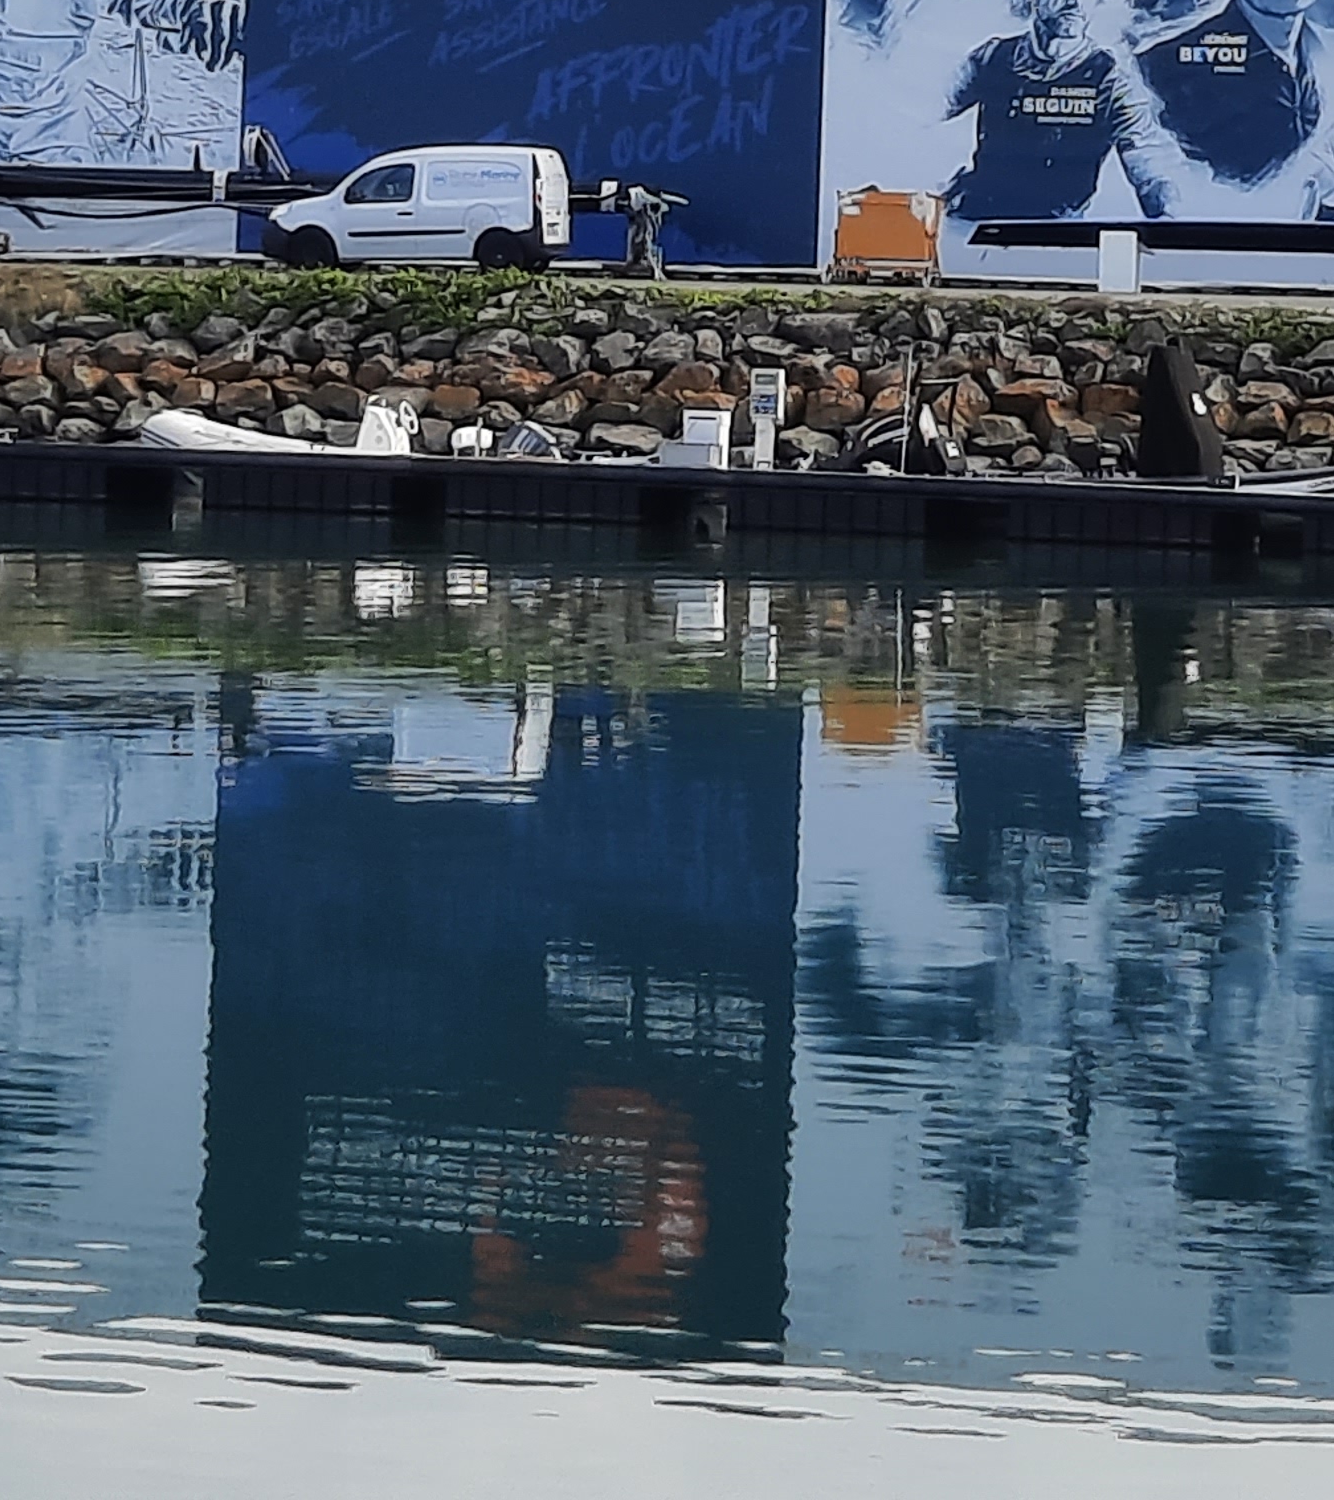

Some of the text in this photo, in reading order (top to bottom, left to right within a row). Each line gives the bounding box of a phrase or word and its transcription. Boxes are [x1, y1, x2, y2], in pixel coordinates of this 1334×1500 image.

[1179, 46, 1248, 63] BEYOU
[526, 0, 811, 128] AFFRONTER
[1022, 97, 1096, 114] SEGUIN
